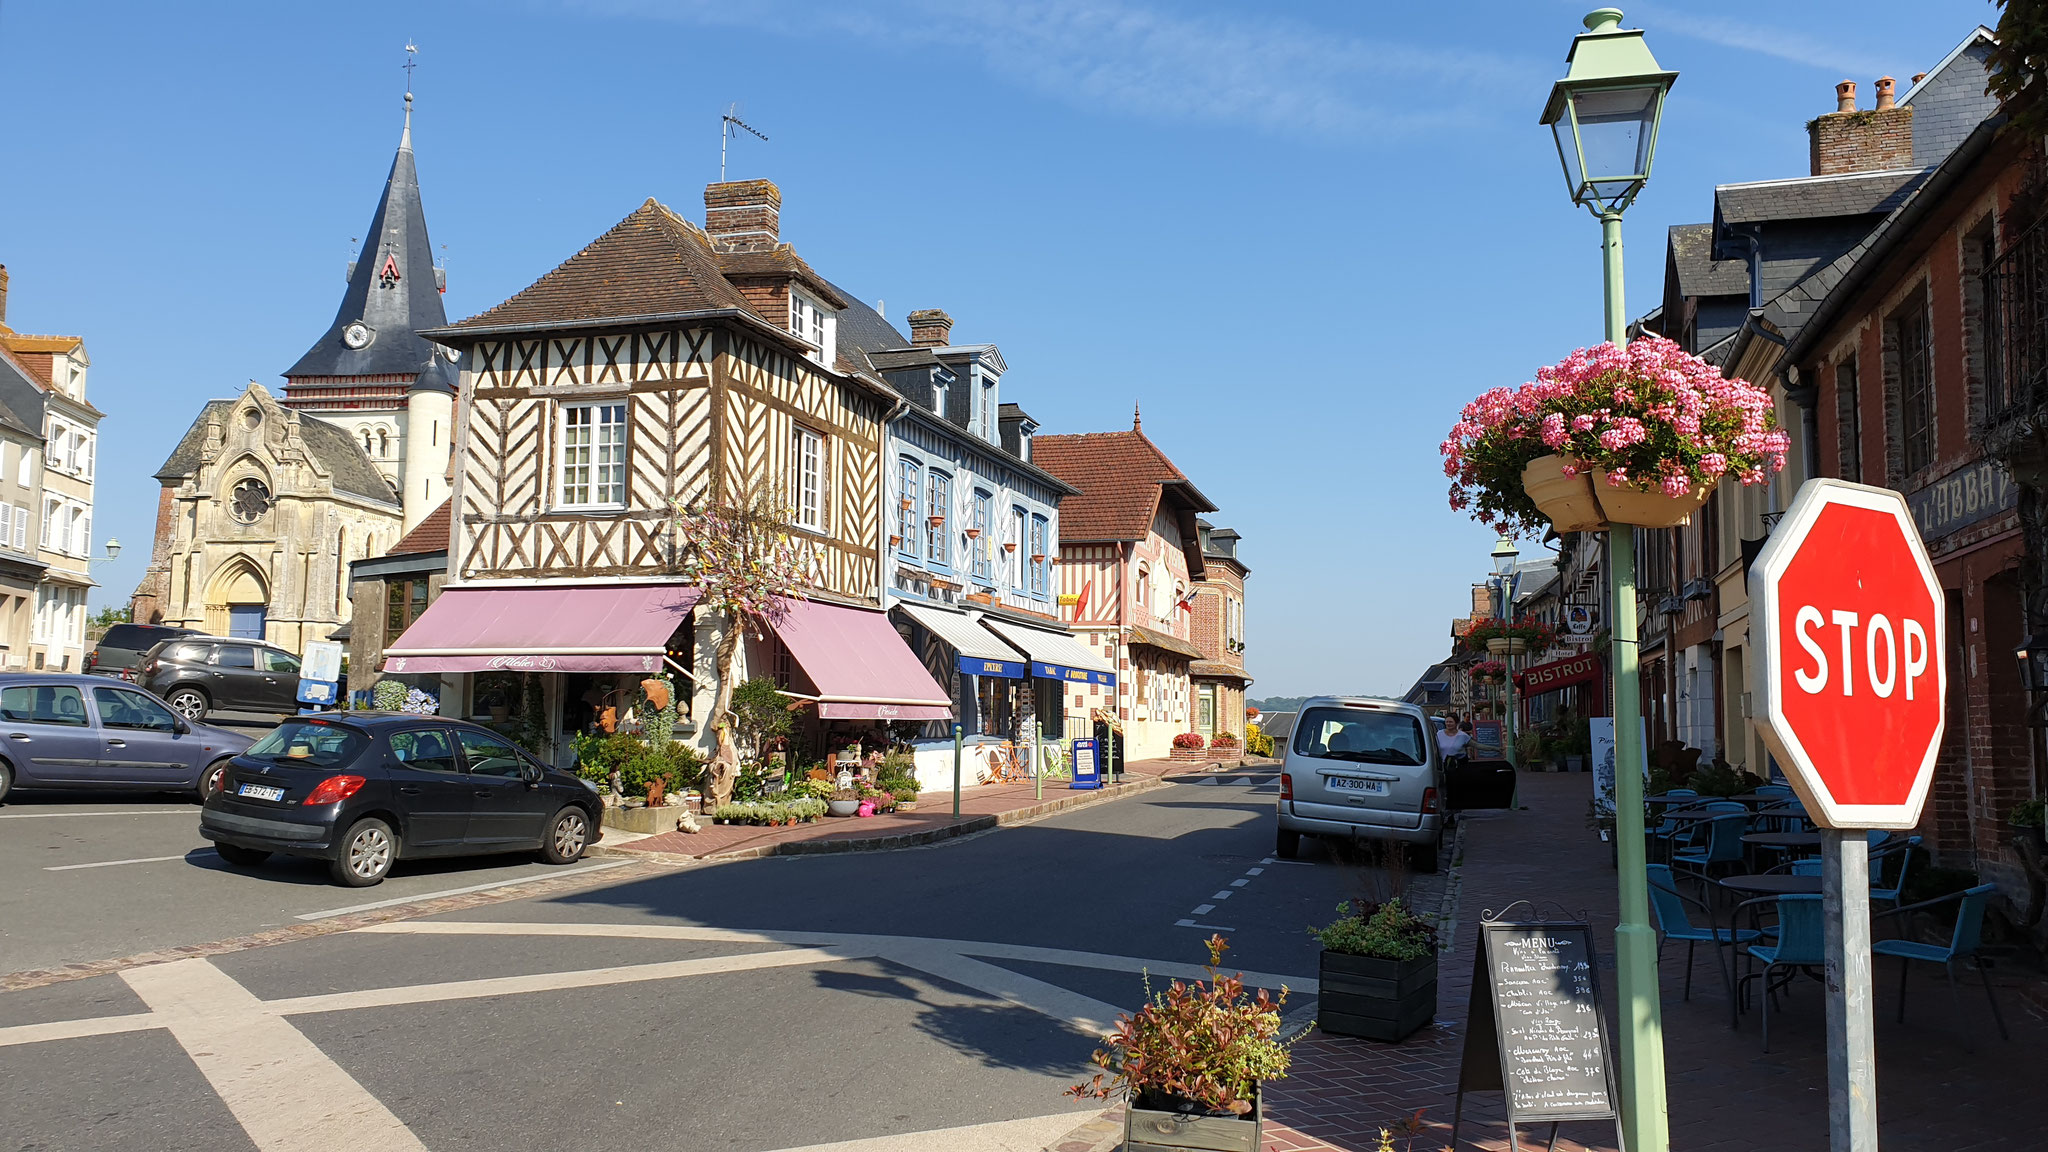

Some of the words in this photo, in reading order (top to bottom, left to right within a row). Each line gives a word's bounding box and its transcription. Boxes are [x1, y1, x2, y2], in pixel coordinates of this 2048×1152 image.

[1566, 635, 1593, 643] Bistrot
[1794, 604, 1928, 701] STOP
[1527, 658, 1592, 686] BISTROT
[1521, 937, 1555, 949] MENU
